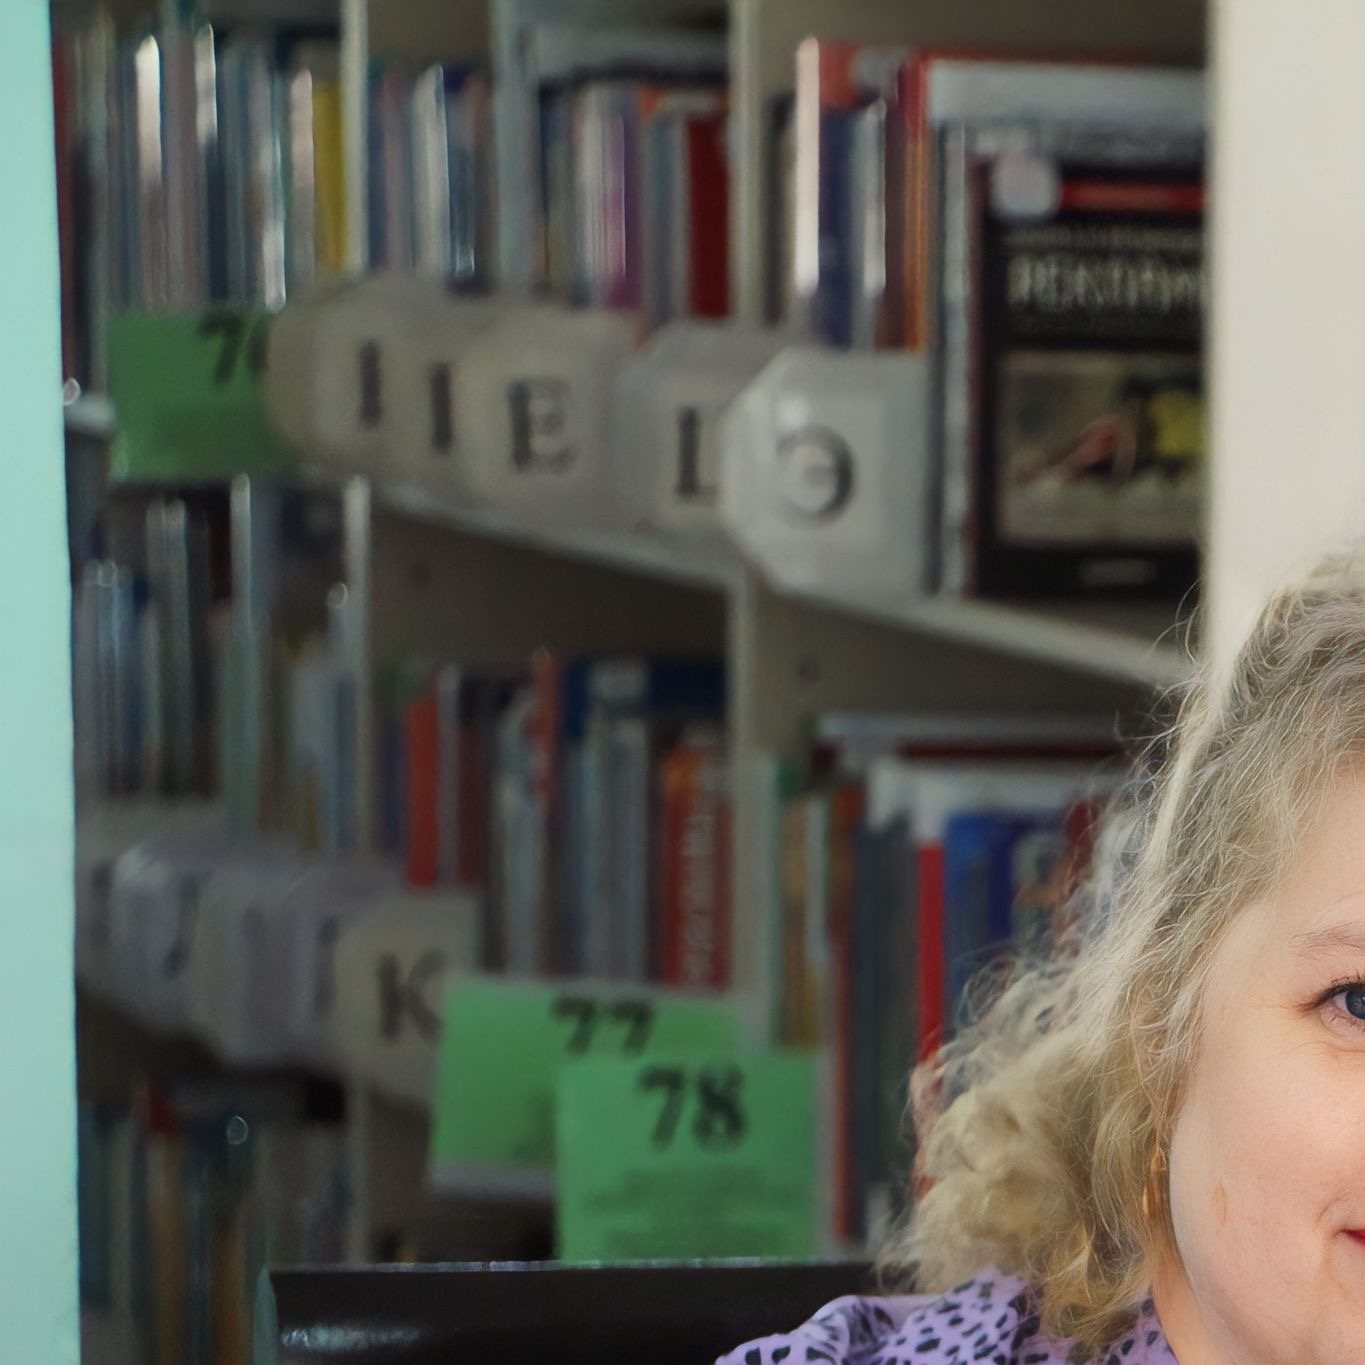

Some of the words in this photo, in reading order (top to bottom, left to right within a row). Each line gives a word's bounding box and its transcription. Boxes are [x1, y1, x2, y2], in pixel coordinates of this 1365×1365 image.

[773, 423, 858, 530] Э
[547, 996, 657, 1058] 77
[637, 1062, 747, 1154] 78
